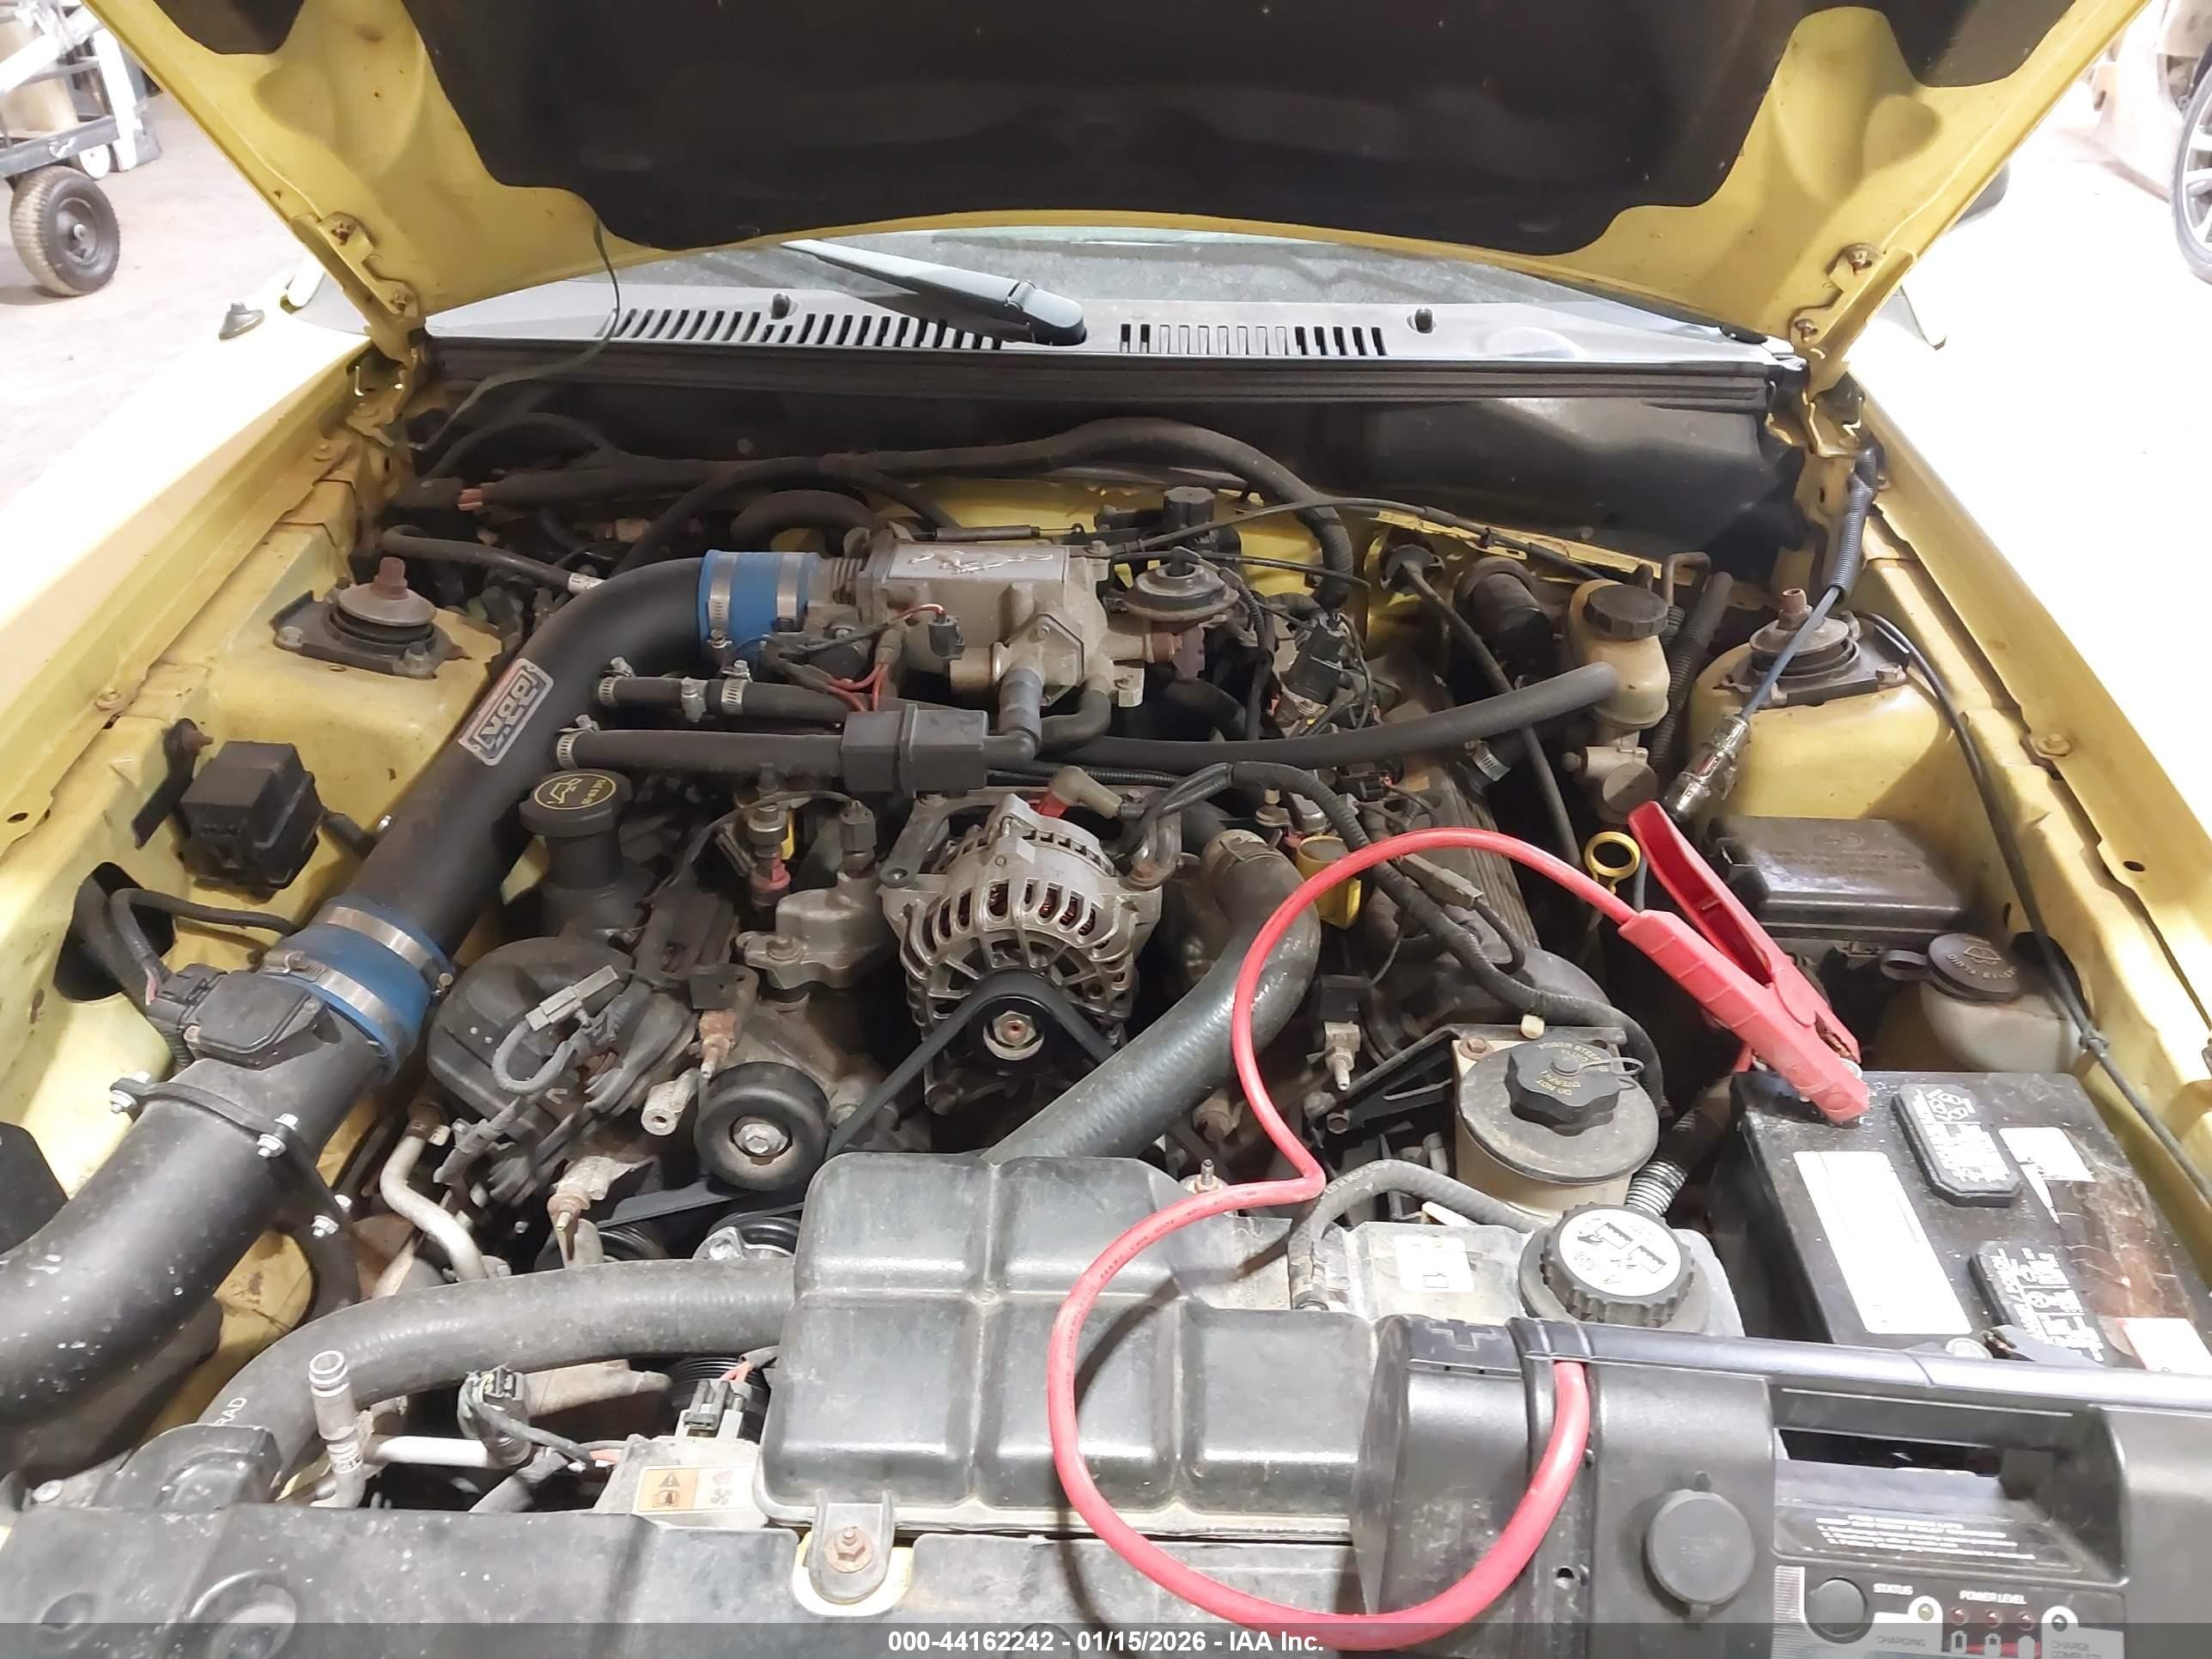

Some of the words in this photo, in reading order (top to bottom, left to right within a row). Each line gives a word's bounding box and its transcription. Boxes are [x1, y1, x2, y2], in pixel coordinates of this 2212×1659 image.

[481, 675, 538, 749] BBK
[1534, 1079, 1557, 1091] NOT
[1557, 1088, 1574, 1097] DO
[214, 1397, 248, 1426] RAD
[1959, 1590, 1997, 1603] POWER
[1997, 1593, 2027, 1605] LEVEL
[1875, 1635, 1926, 1648] CHARGING
[2051, 1640, 2091, 1652] CHARGE
